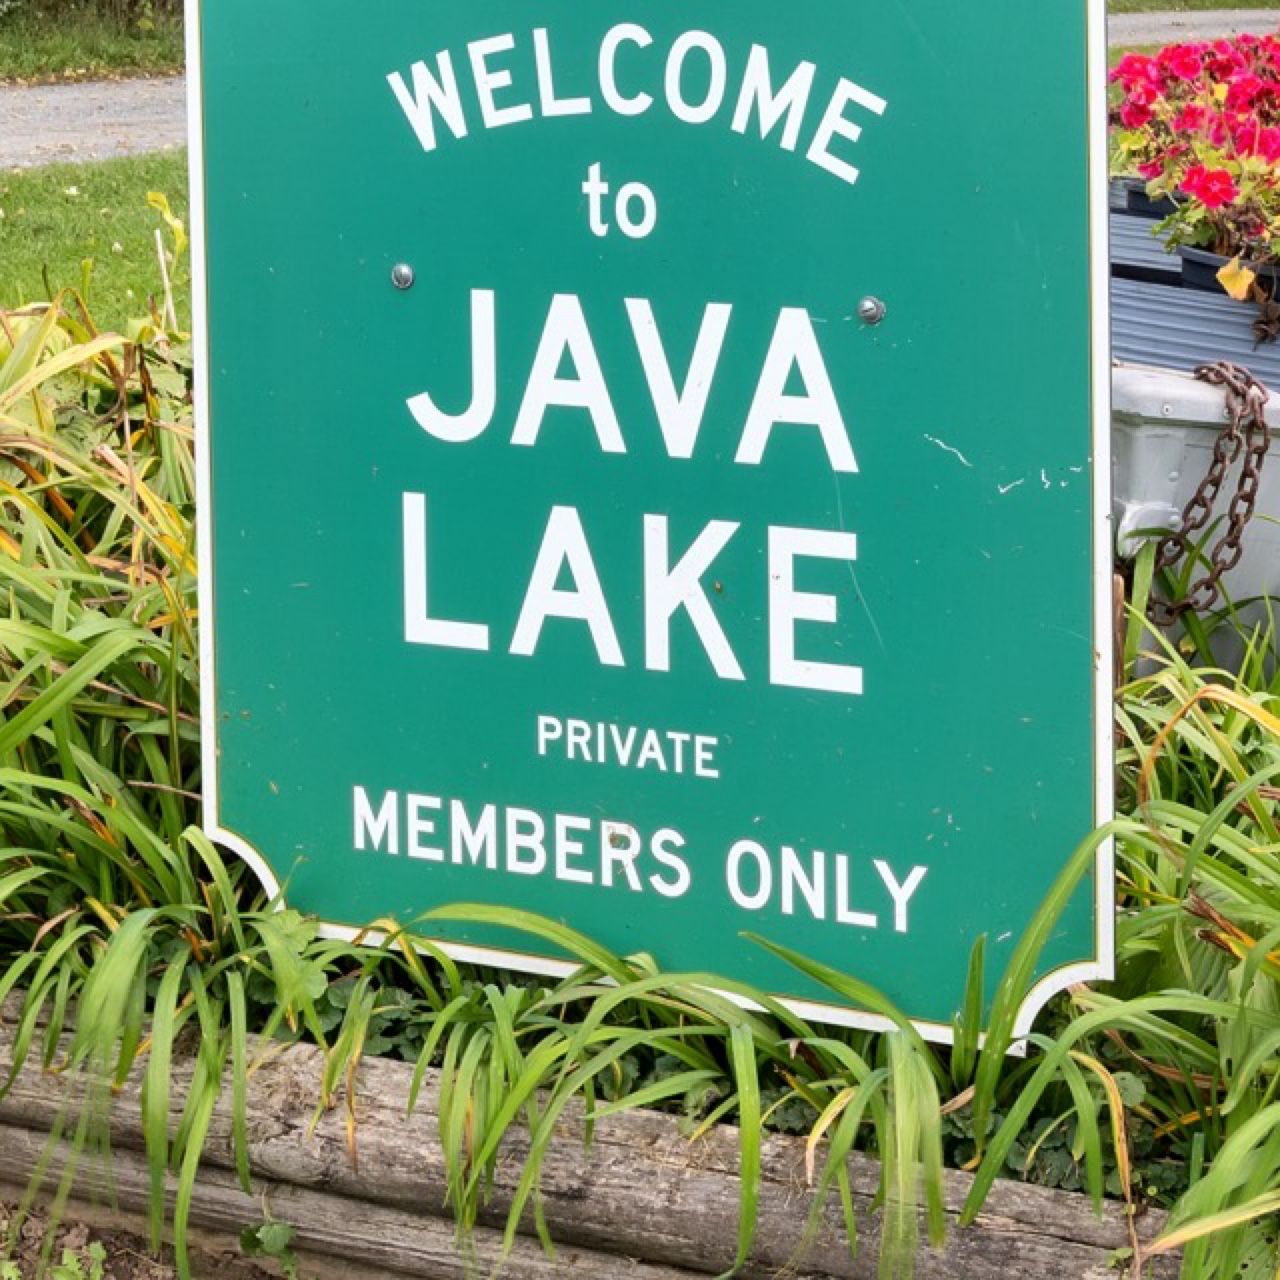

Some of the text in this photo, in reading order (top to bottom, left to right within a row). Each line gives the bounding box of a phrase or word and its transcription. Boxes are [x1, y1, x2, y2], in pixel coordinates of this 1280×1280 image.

[386, 23, 887, 184] WELCOME
[582, 163, 657, 238] to
[406, 289, 859, 473] JAVA
[402, 492, 863, 694] LAKE
[537, 715, 719, 778] PRIVATE
[352, 786, 928, 933] MEMBERS ONLY
